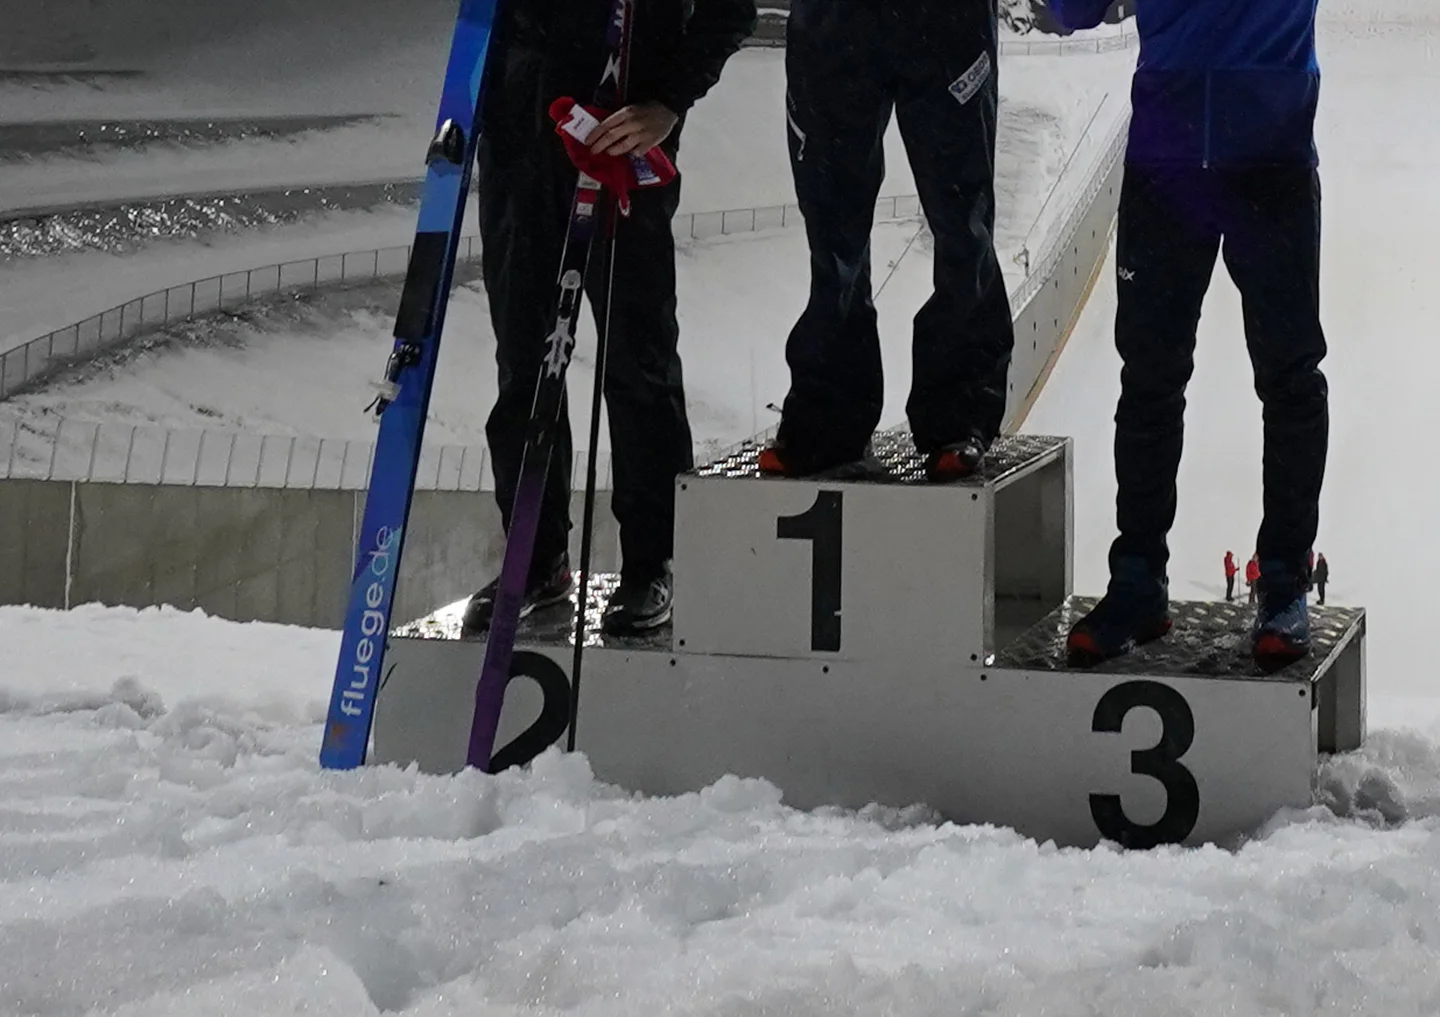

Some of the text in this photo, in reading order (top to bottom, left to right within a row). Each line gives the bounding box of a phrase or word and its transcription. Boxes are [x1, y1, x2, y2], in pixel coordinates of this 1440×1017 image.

[340, 525, 394, 717] fluege.de
[776, 490, 843, 652] 1
[485, 650, 573, 775] 2
[1089, 680, 1200, 850] 3
